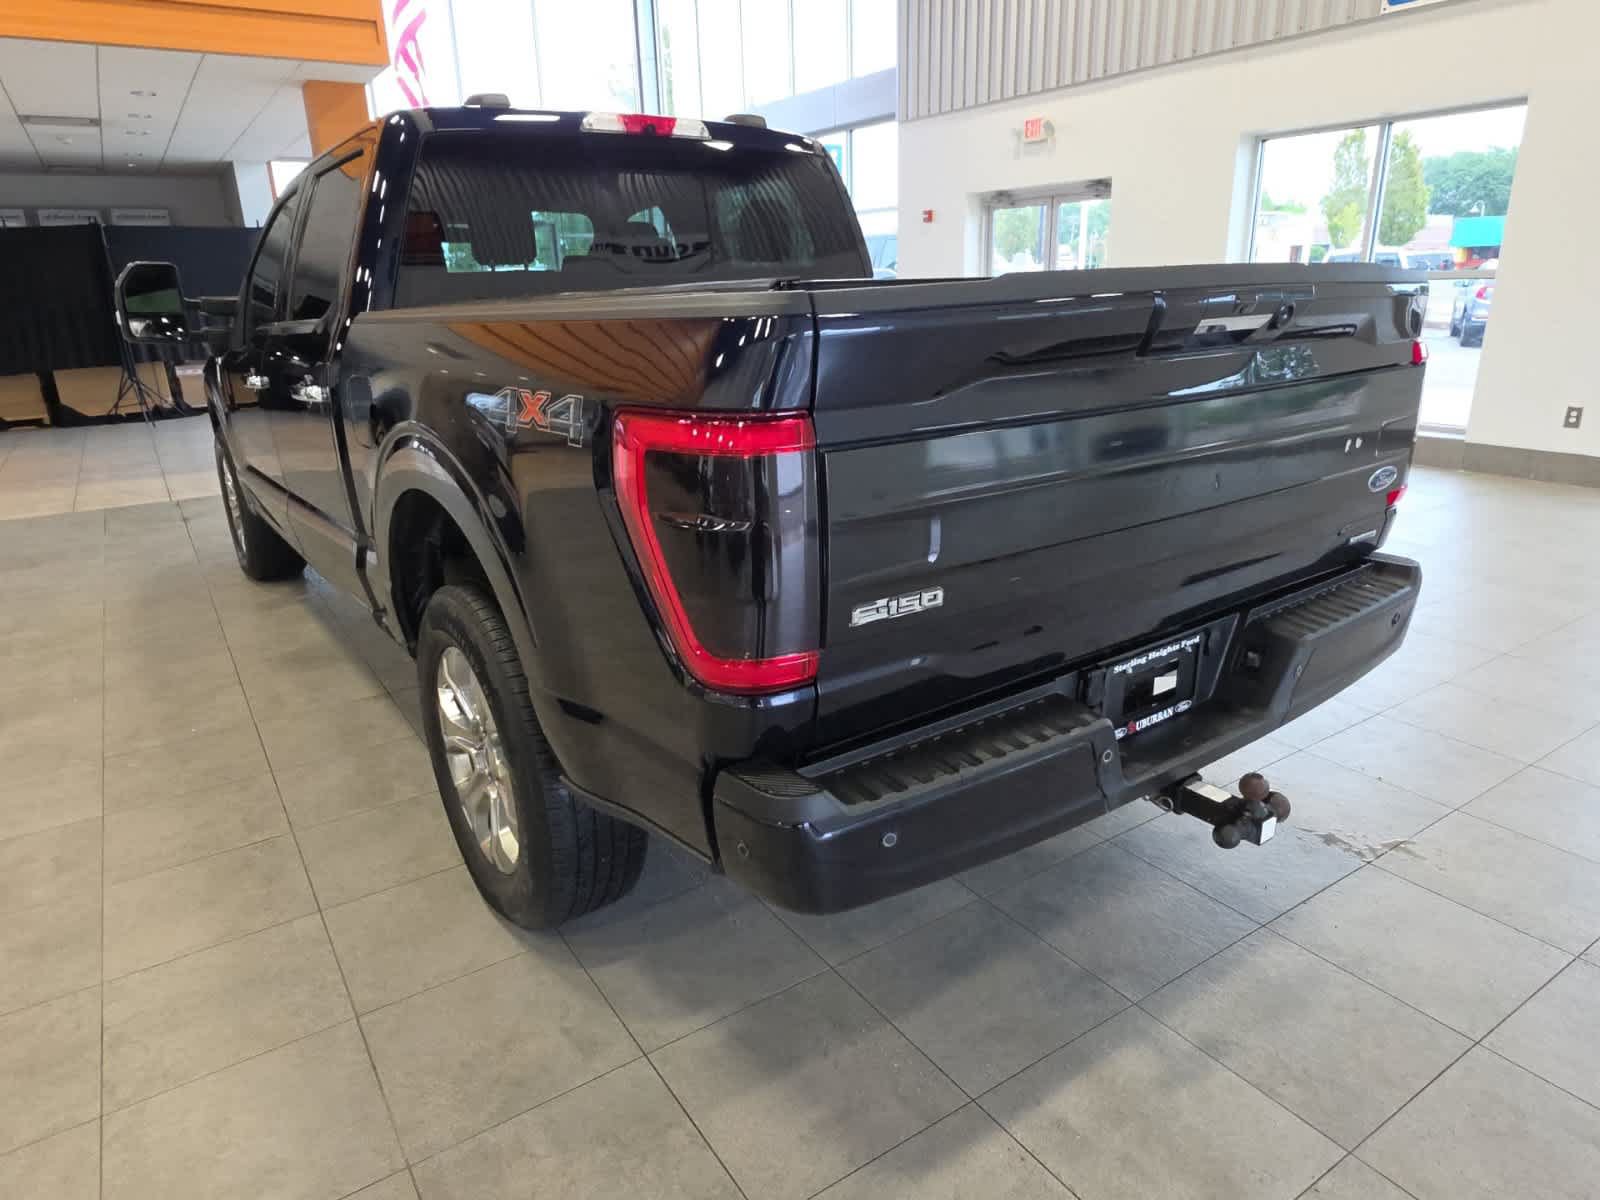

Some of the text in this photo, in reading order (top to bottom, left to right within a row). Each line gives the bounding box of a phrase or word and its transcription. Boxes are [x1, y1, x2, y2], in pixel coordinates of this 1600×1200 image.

[1113, 635, 1200, 674] Sterling Heights Ford
